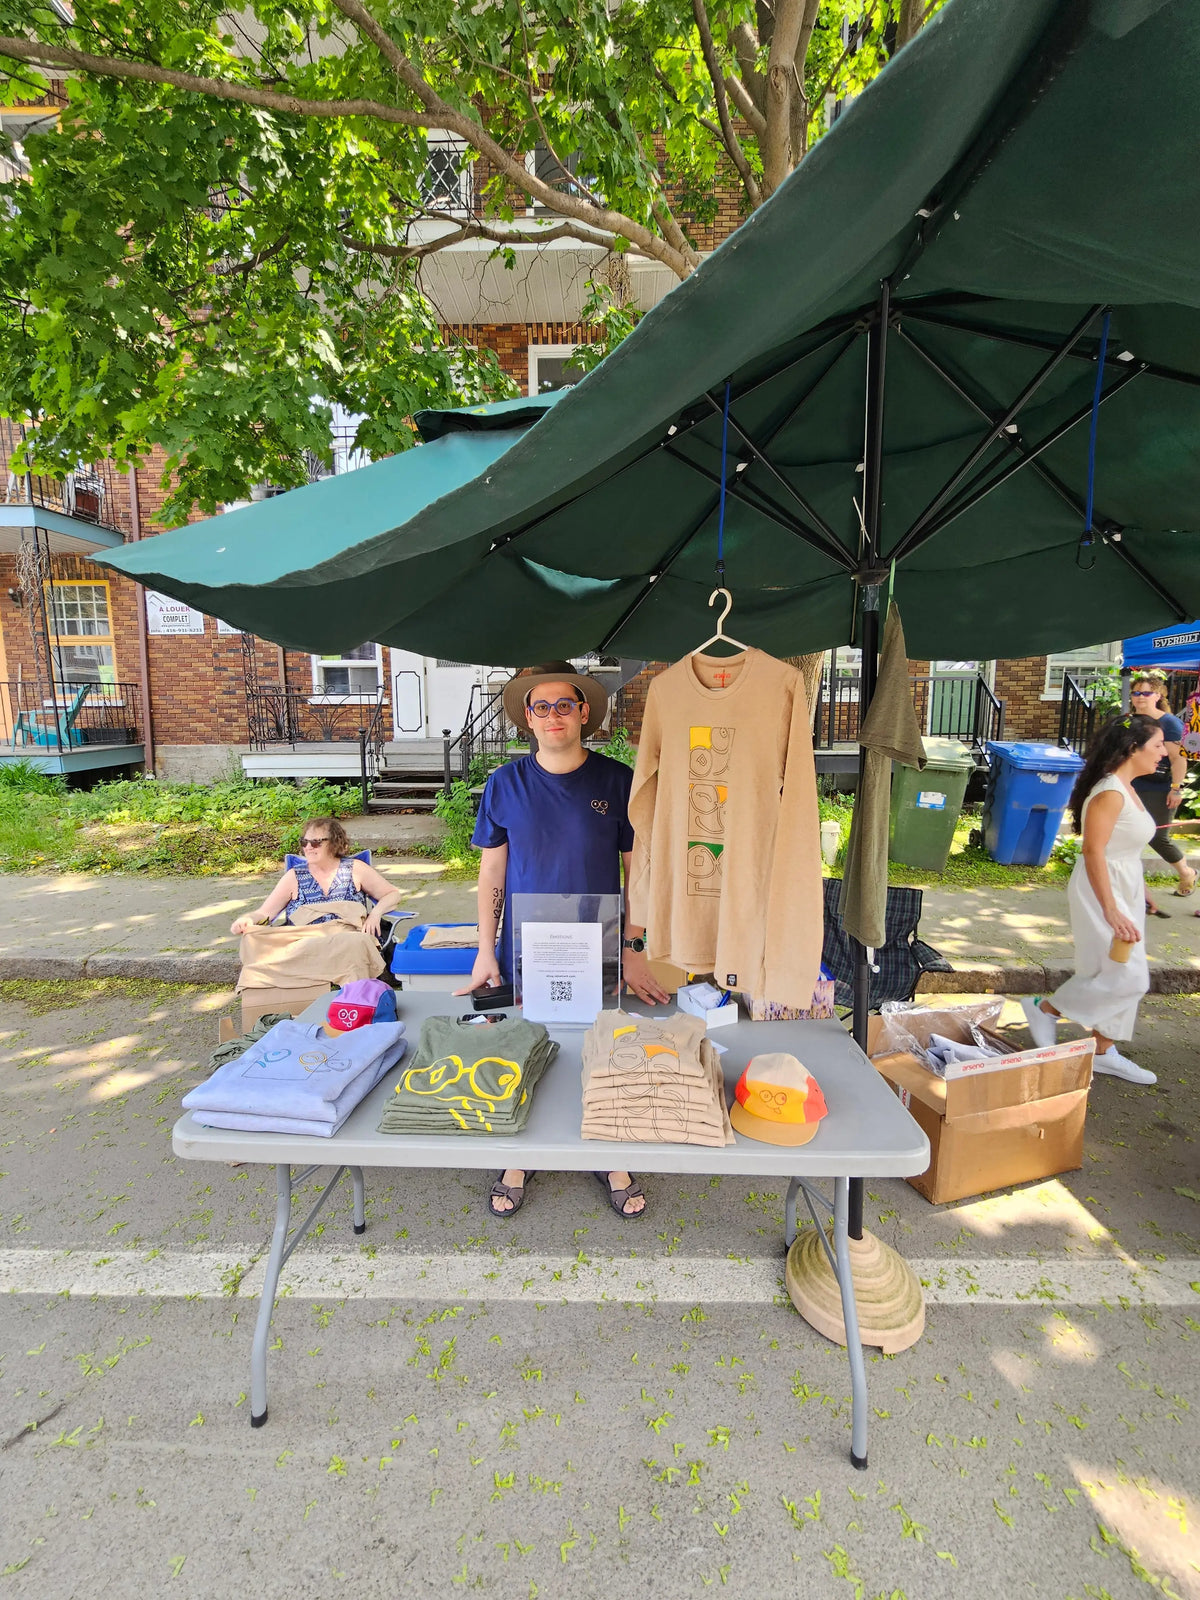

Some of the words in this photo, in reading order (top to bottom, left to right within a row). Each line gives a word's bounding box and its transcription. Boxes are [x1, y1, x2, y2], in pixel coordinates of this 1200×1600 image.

[163, 615, 188, 623] COMPLET
[1154, 632, 1200, 648] EVERBILT
[962, 1062, 985, 1072] arseno
[1000, 1056, 1022, 1066] arseno
[1036, 1050, 1056, 1060] arseno
[1069, 1044, 1087, 1053] arseno
